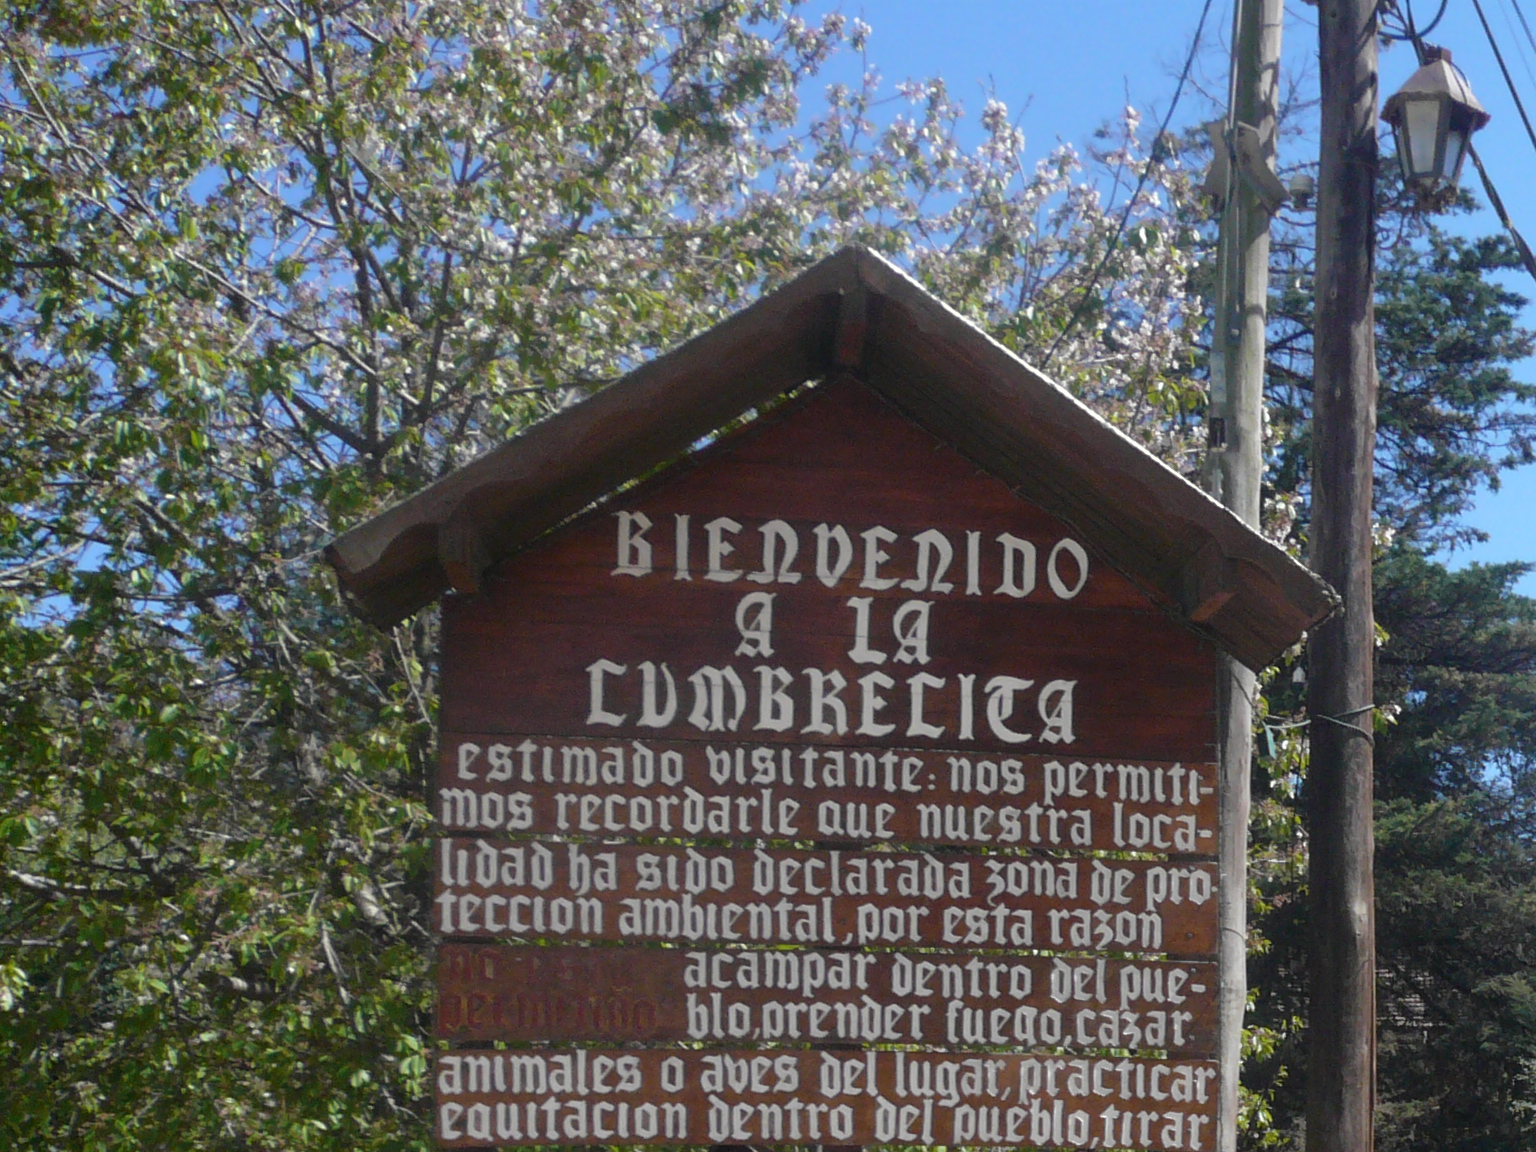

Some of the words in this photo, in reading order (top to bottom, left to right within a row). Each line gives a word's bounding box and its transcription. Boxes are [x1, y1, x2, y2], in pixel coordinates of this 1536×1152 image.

[610, 510, 1090, 600] BIENVENIDO
[734, 592, 775, 659] A
[847, 596, 933, 665] LA
[585, 658, 1080, 745] CUMBRECITA
[457, 739, 684, 788] estimado
[705, 744, 936, 793] visitante:
[948, 756, 1026, 795] nos
[439, 787, 533, 830] mos
[554, 786, 801, 836] recordarle
[817, 800, 896, 838] que
[916, 801, 1092, 845] nuestra
[440, 838, 552, 890] lidad
[568, 843, 618, 896] ha
[636, 848, 735, 896] sido
[752, 848, 971, 900] declarada
[984, 858, 1079, 908] zona
[1090, 859, 1136, 905] de
[434, 888, 603, 935] teccion
[942, 904, 1033, 947] esta
[1047, 907, 1162, 950] razon
[683, 951, 877, 998] acampar
[891, 952, 1032, 1000] dentro
[1050, 956, 1106, 1003] del
[438, 1050, 642, 1095] animales
[661, 1055, 685, 1093] o
[700, 1053, 799, 1094] aves
[820, 1050, 878, 1098] del
[440, 1095, 687, 1141] equitacion
[708, 1094, 853, 1143] dentro
[875, 1096, 934, 1145] del
